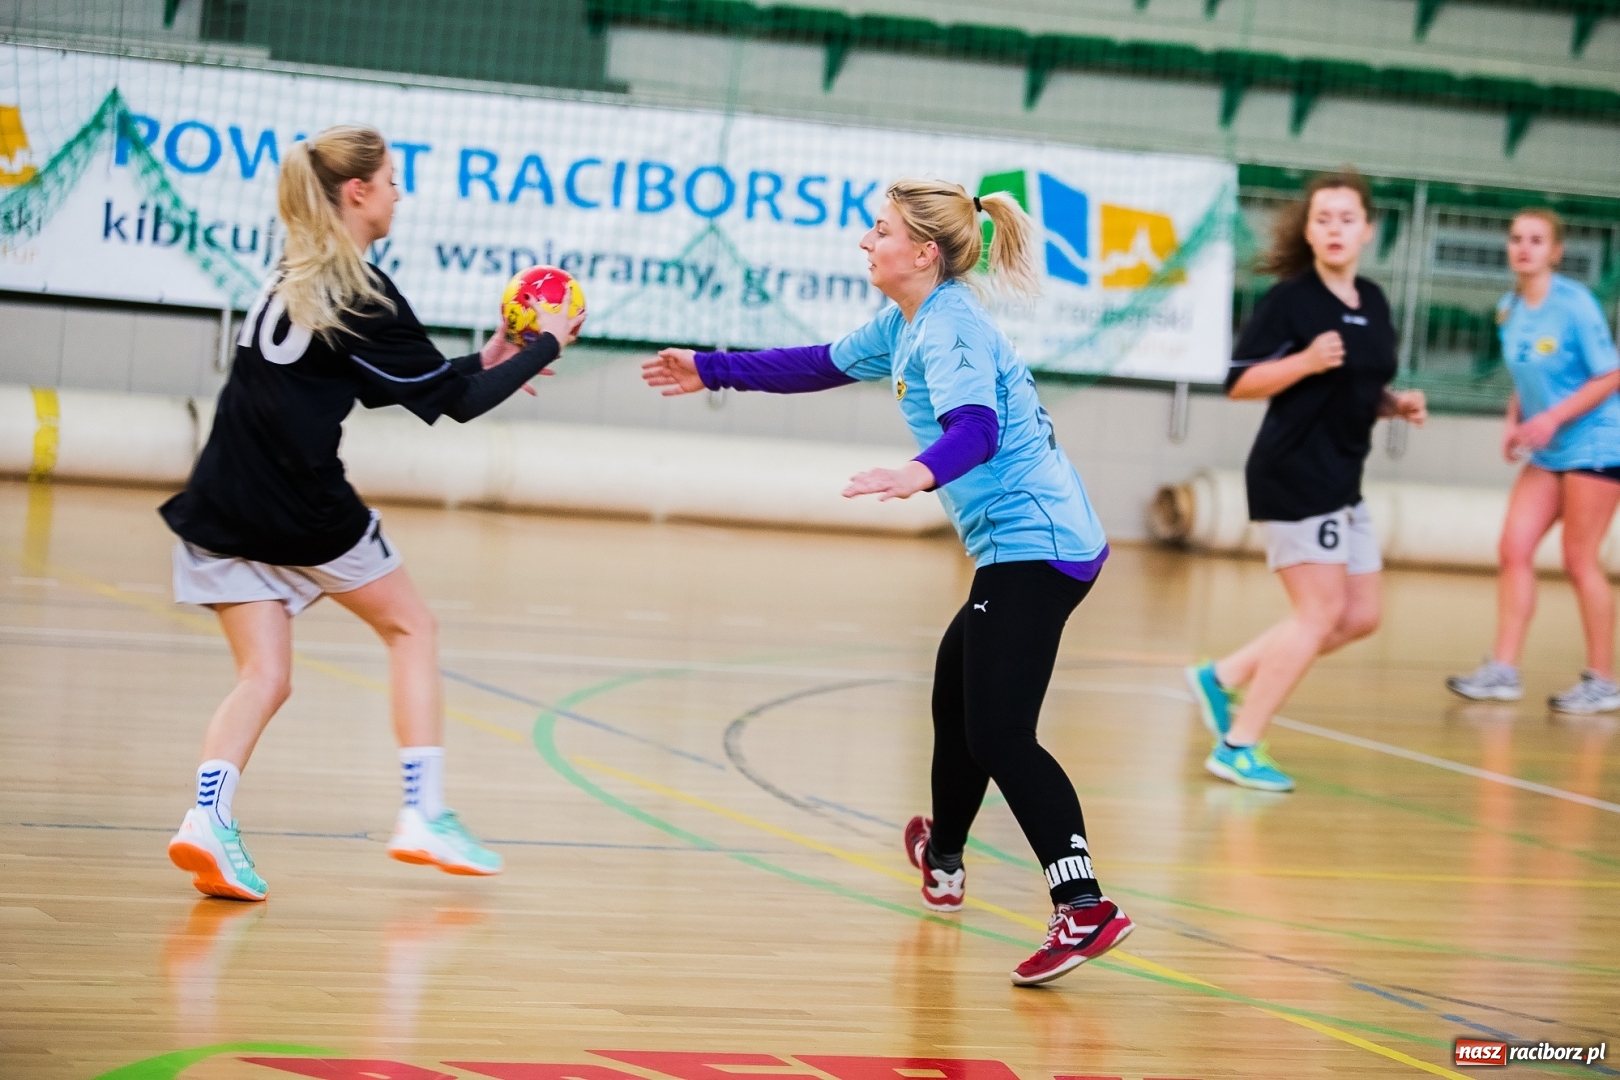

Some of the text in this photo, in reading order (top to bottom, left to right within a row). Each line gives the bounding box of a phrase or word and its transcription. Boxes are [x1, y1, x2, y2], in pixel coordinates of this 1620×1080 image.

[115, 113, 880, 228] POWT RACIBORSK
[103, 201, 400, 272] kibicujy,
[741, 265, 888, 311] gram
[1318, 519, 1339, 549] 6
